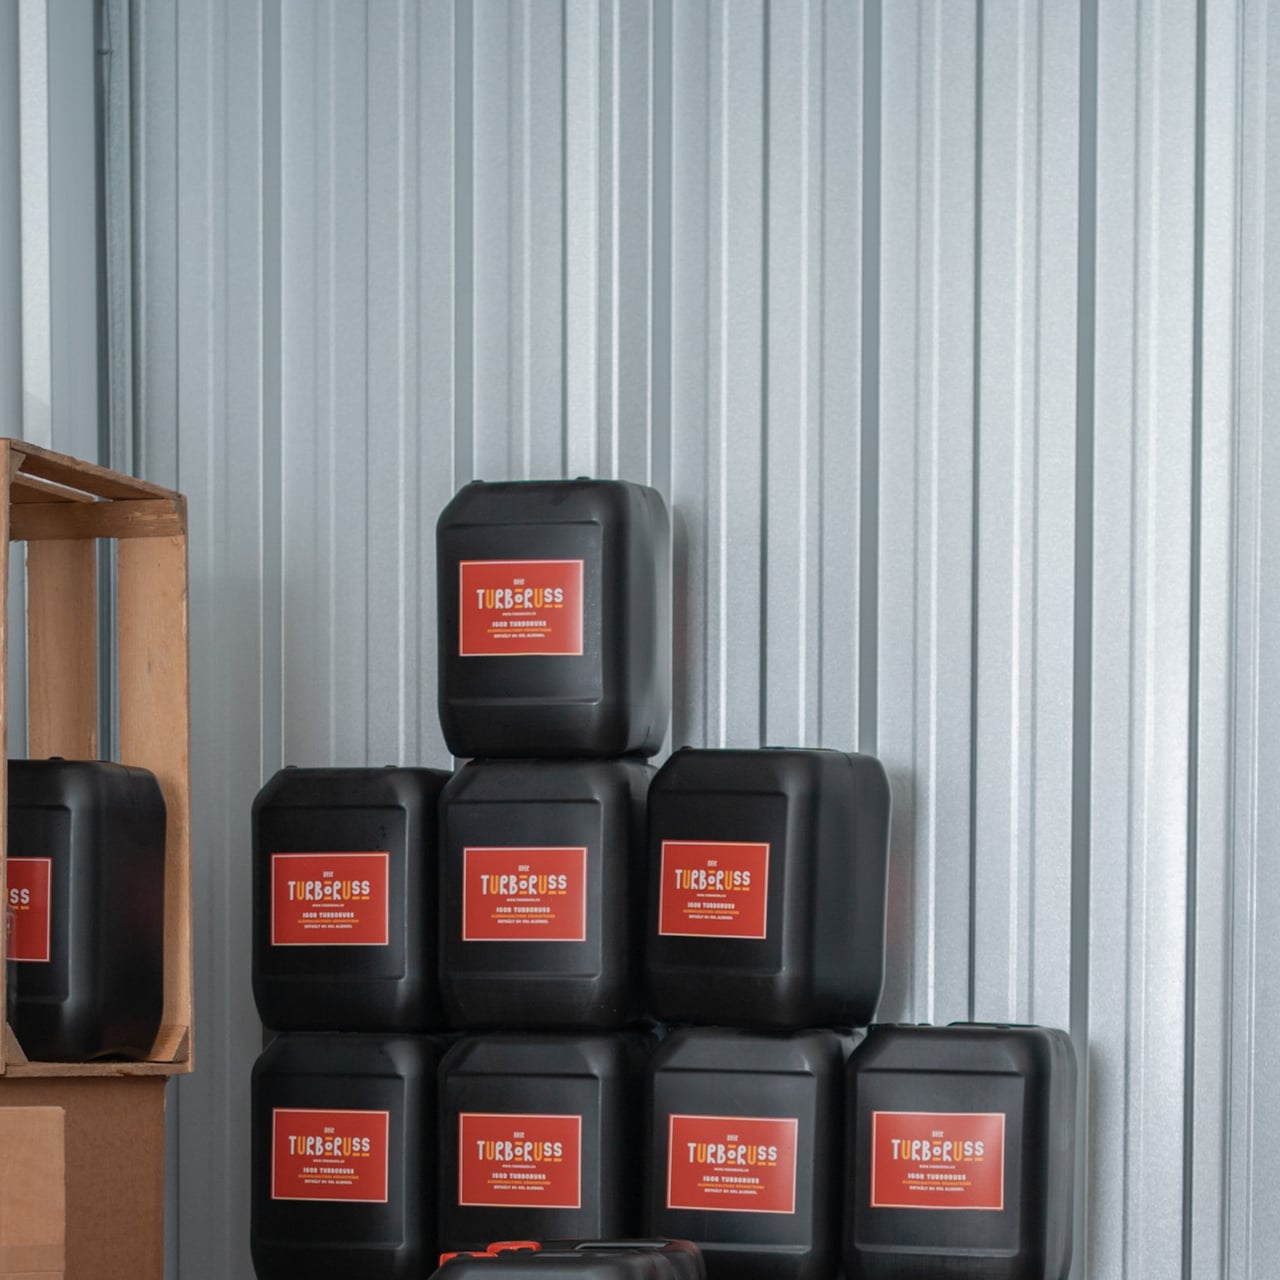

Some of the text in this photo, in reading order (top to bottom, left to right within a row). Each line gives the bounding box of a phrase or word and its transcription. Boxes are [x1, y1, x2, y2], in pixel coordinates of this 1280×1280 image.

[476, 587, 562, 609] TURBORUSS
[288, 880, 369, 900] TURBORUSS
[481, 874, 566, 894] TURBORUSS
[675, 869, 750, 891] TURBORUSS
[288, 1135, 370, 1156] TURBORUSS
[477, 1140, 562, 1162] TURBORUSS
[687, 1142, 777, 1166] TURBORUSS
[891, 1139, 984, 1162] TURBORUSS
